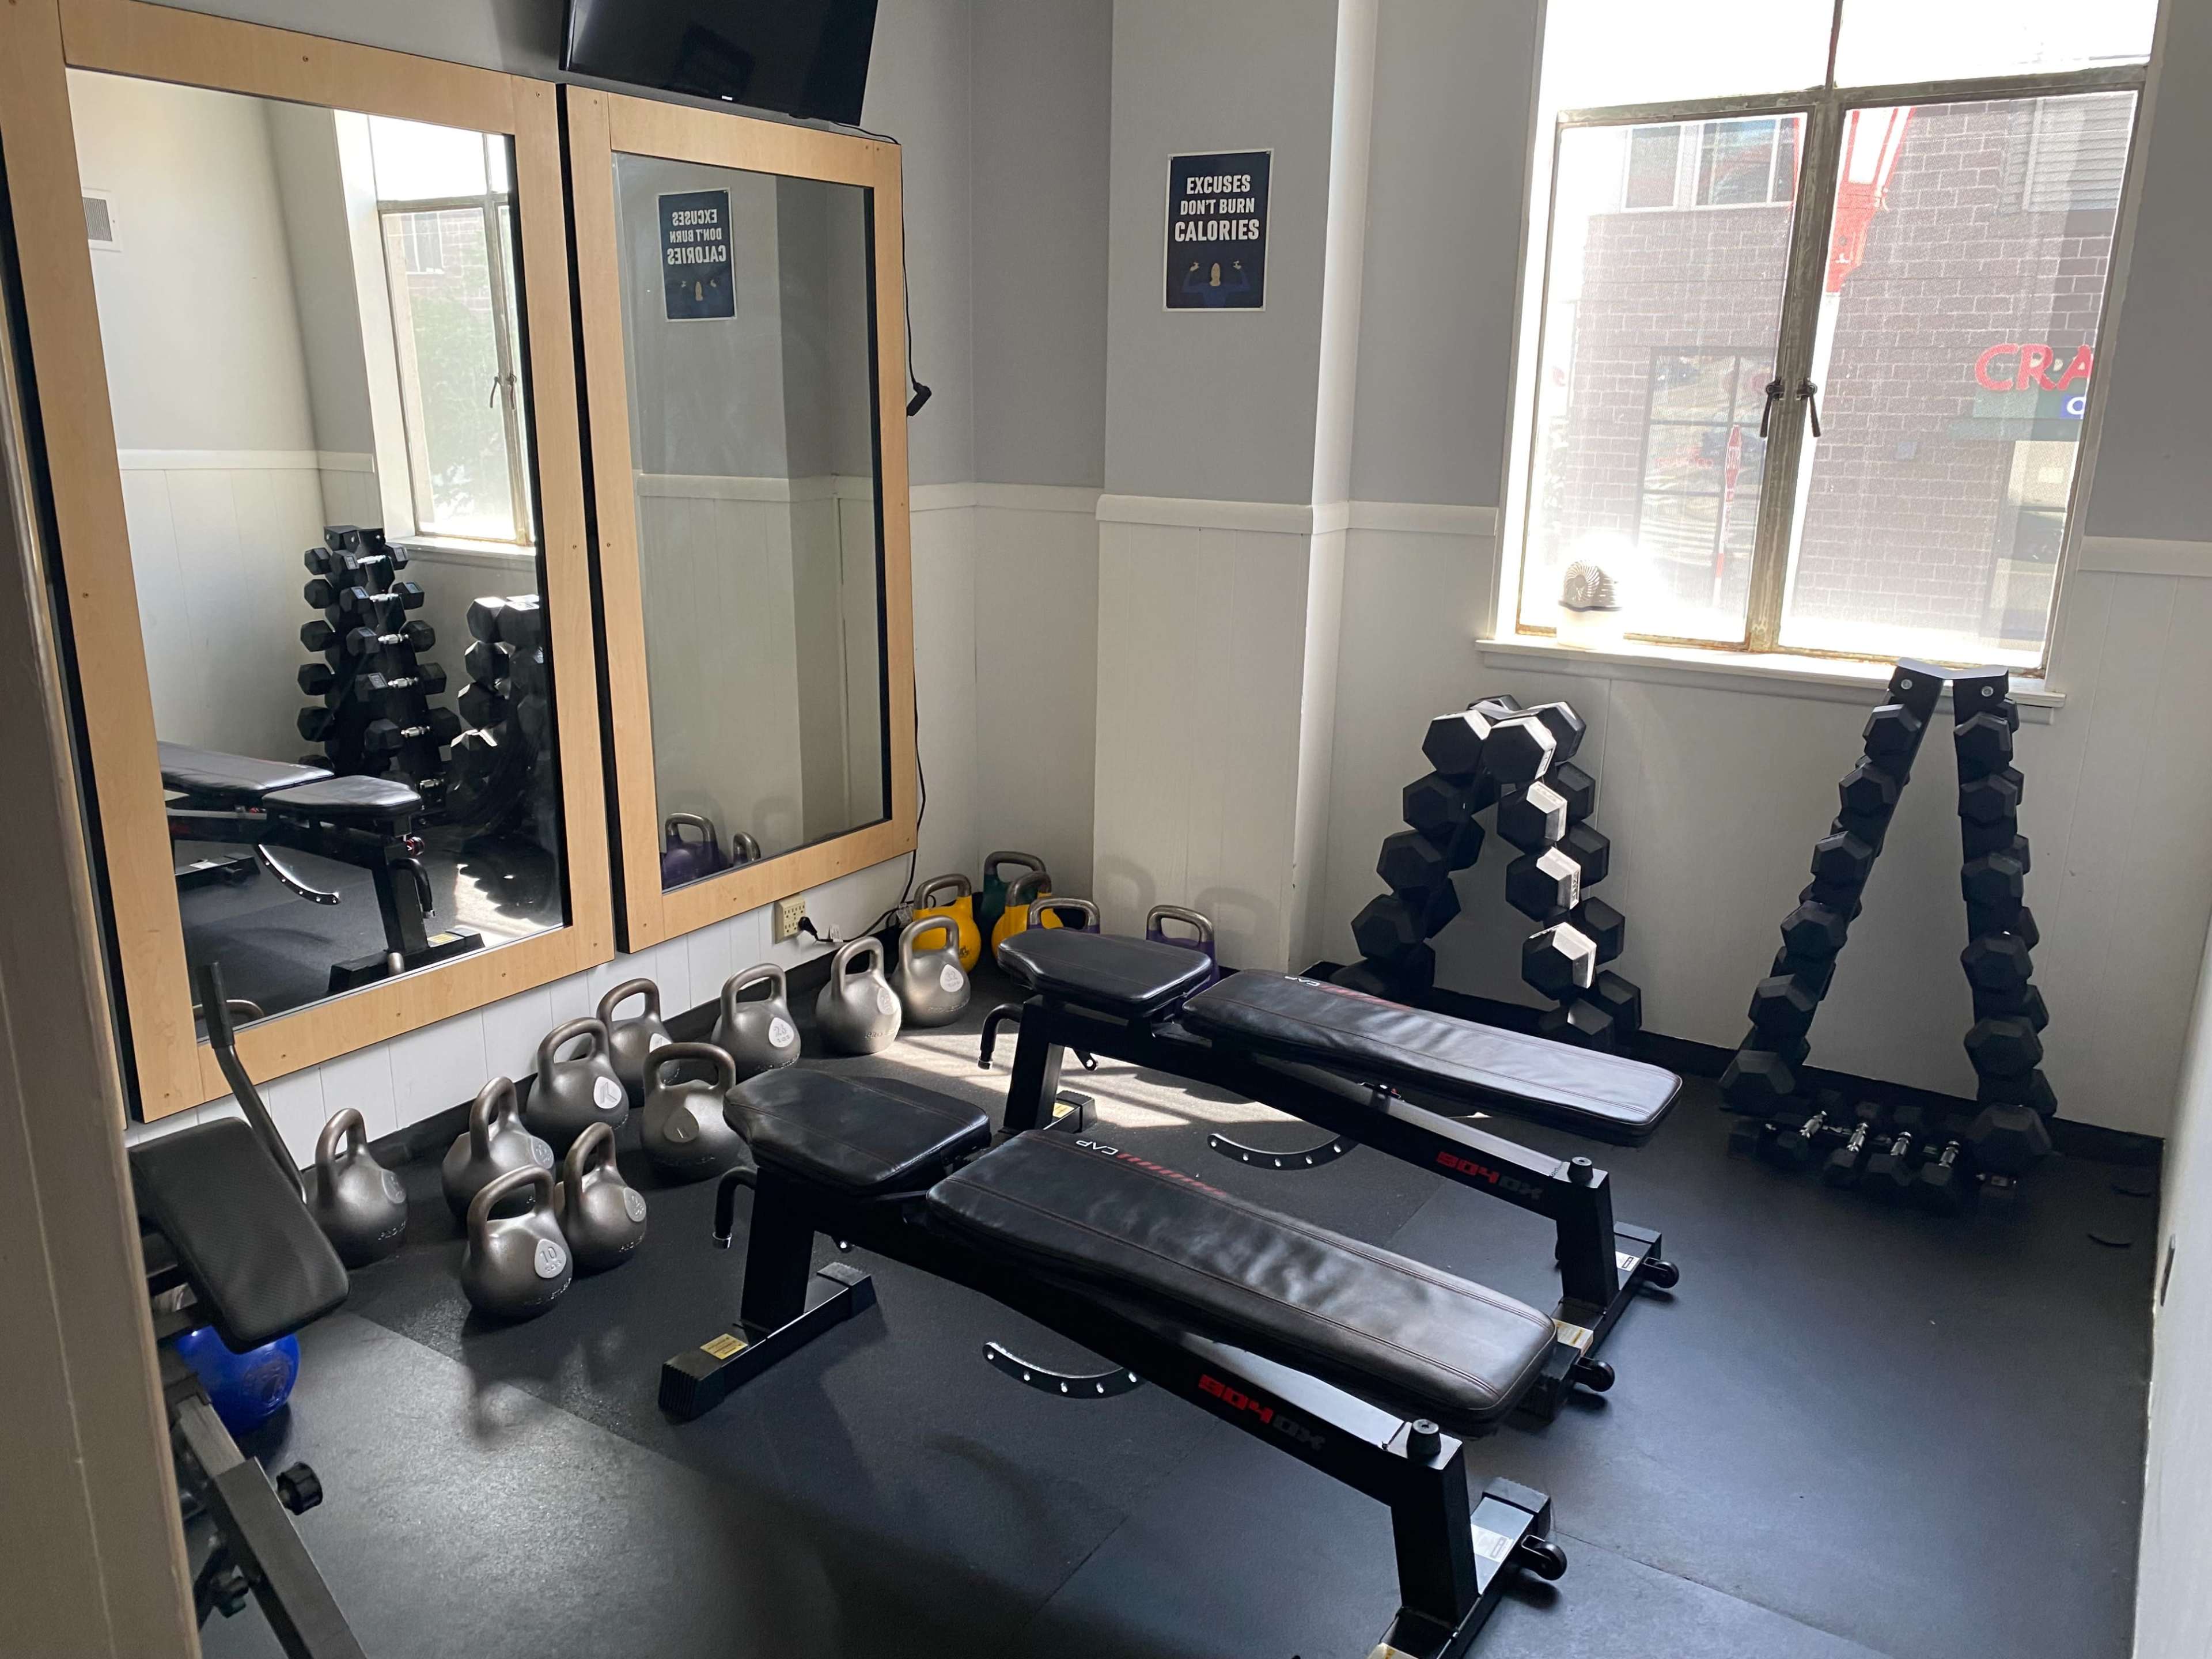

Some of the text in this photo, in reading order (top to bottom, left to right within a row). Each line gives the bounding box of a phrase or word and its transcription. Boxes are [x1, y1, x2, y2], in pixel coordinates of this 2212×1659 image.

[1187, 175, 1251, 194] EXCUSES
[1219, 198, 1255, 214] BURN
[1175, 219, 1259, 241] CALORIES
[1075, 1139, 1119, 1155] CAP
[540, 1246, 557, 1263] 10
